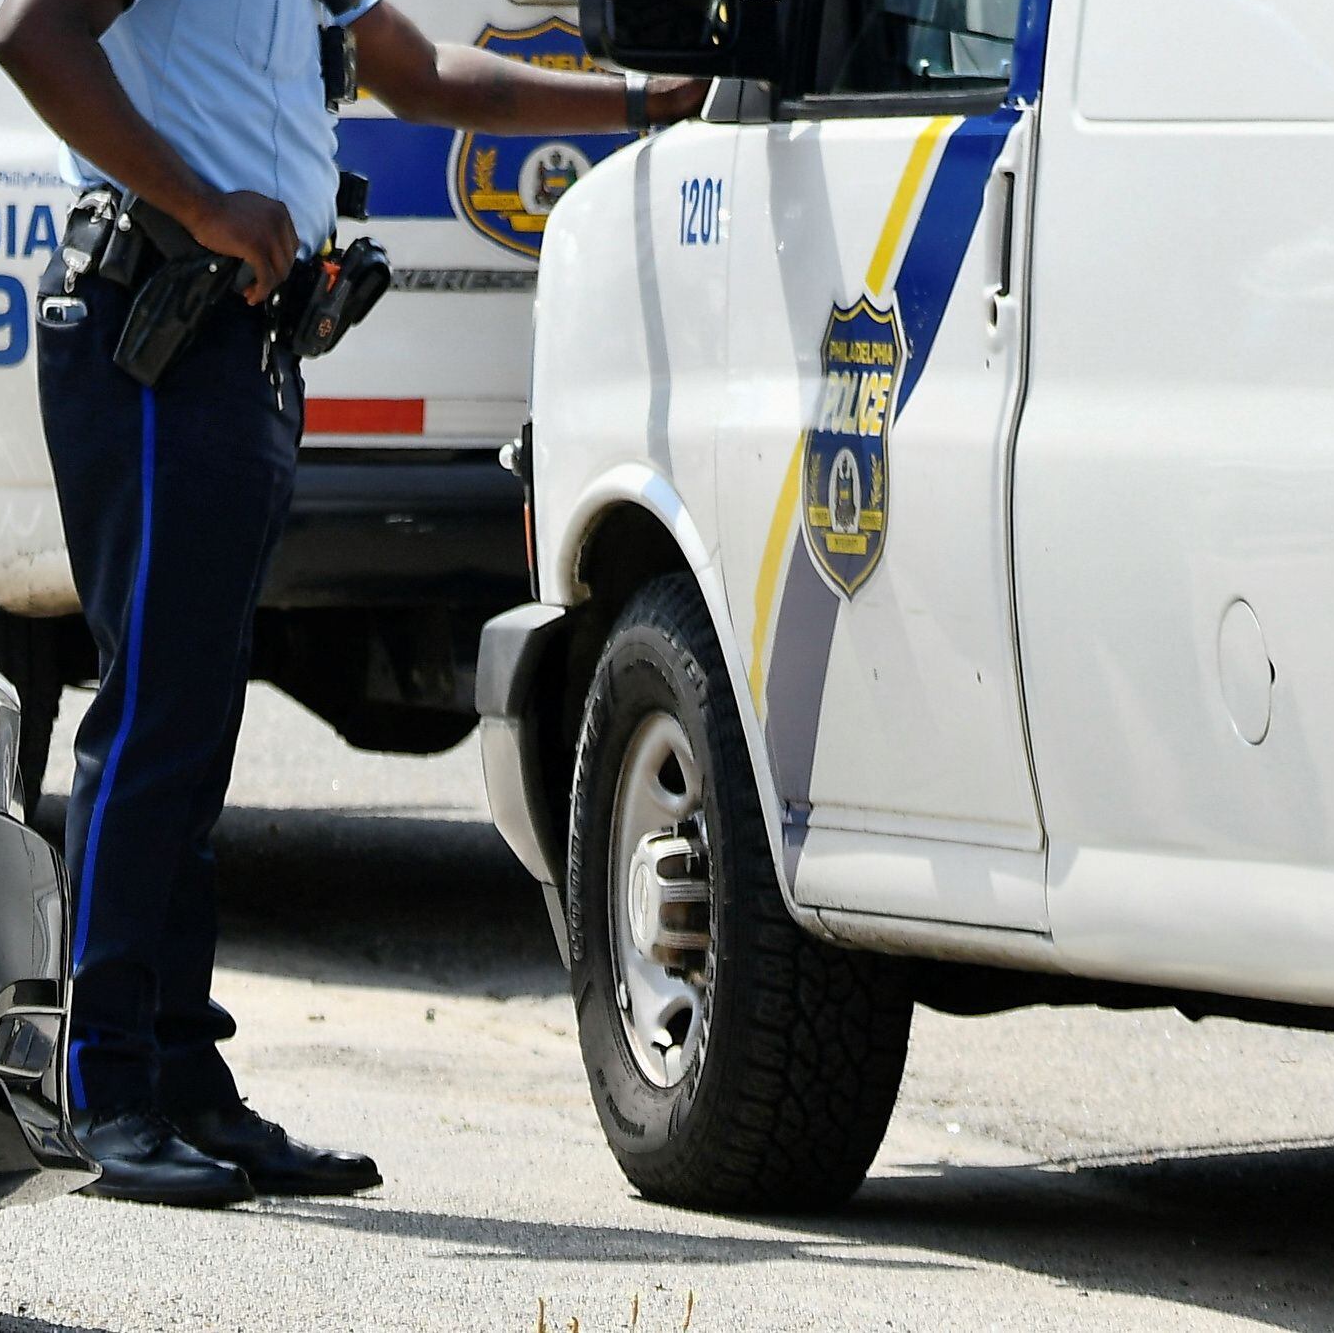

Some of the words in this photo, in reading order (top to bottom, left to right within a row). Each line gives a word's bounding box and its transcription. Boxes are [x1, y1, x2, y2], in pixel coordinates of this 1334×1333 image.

[680, 177, 723, 246] 1201
[829, 341, 894, 366] PHILADELPHIA
[817, 370, 893, 436] POLICE
